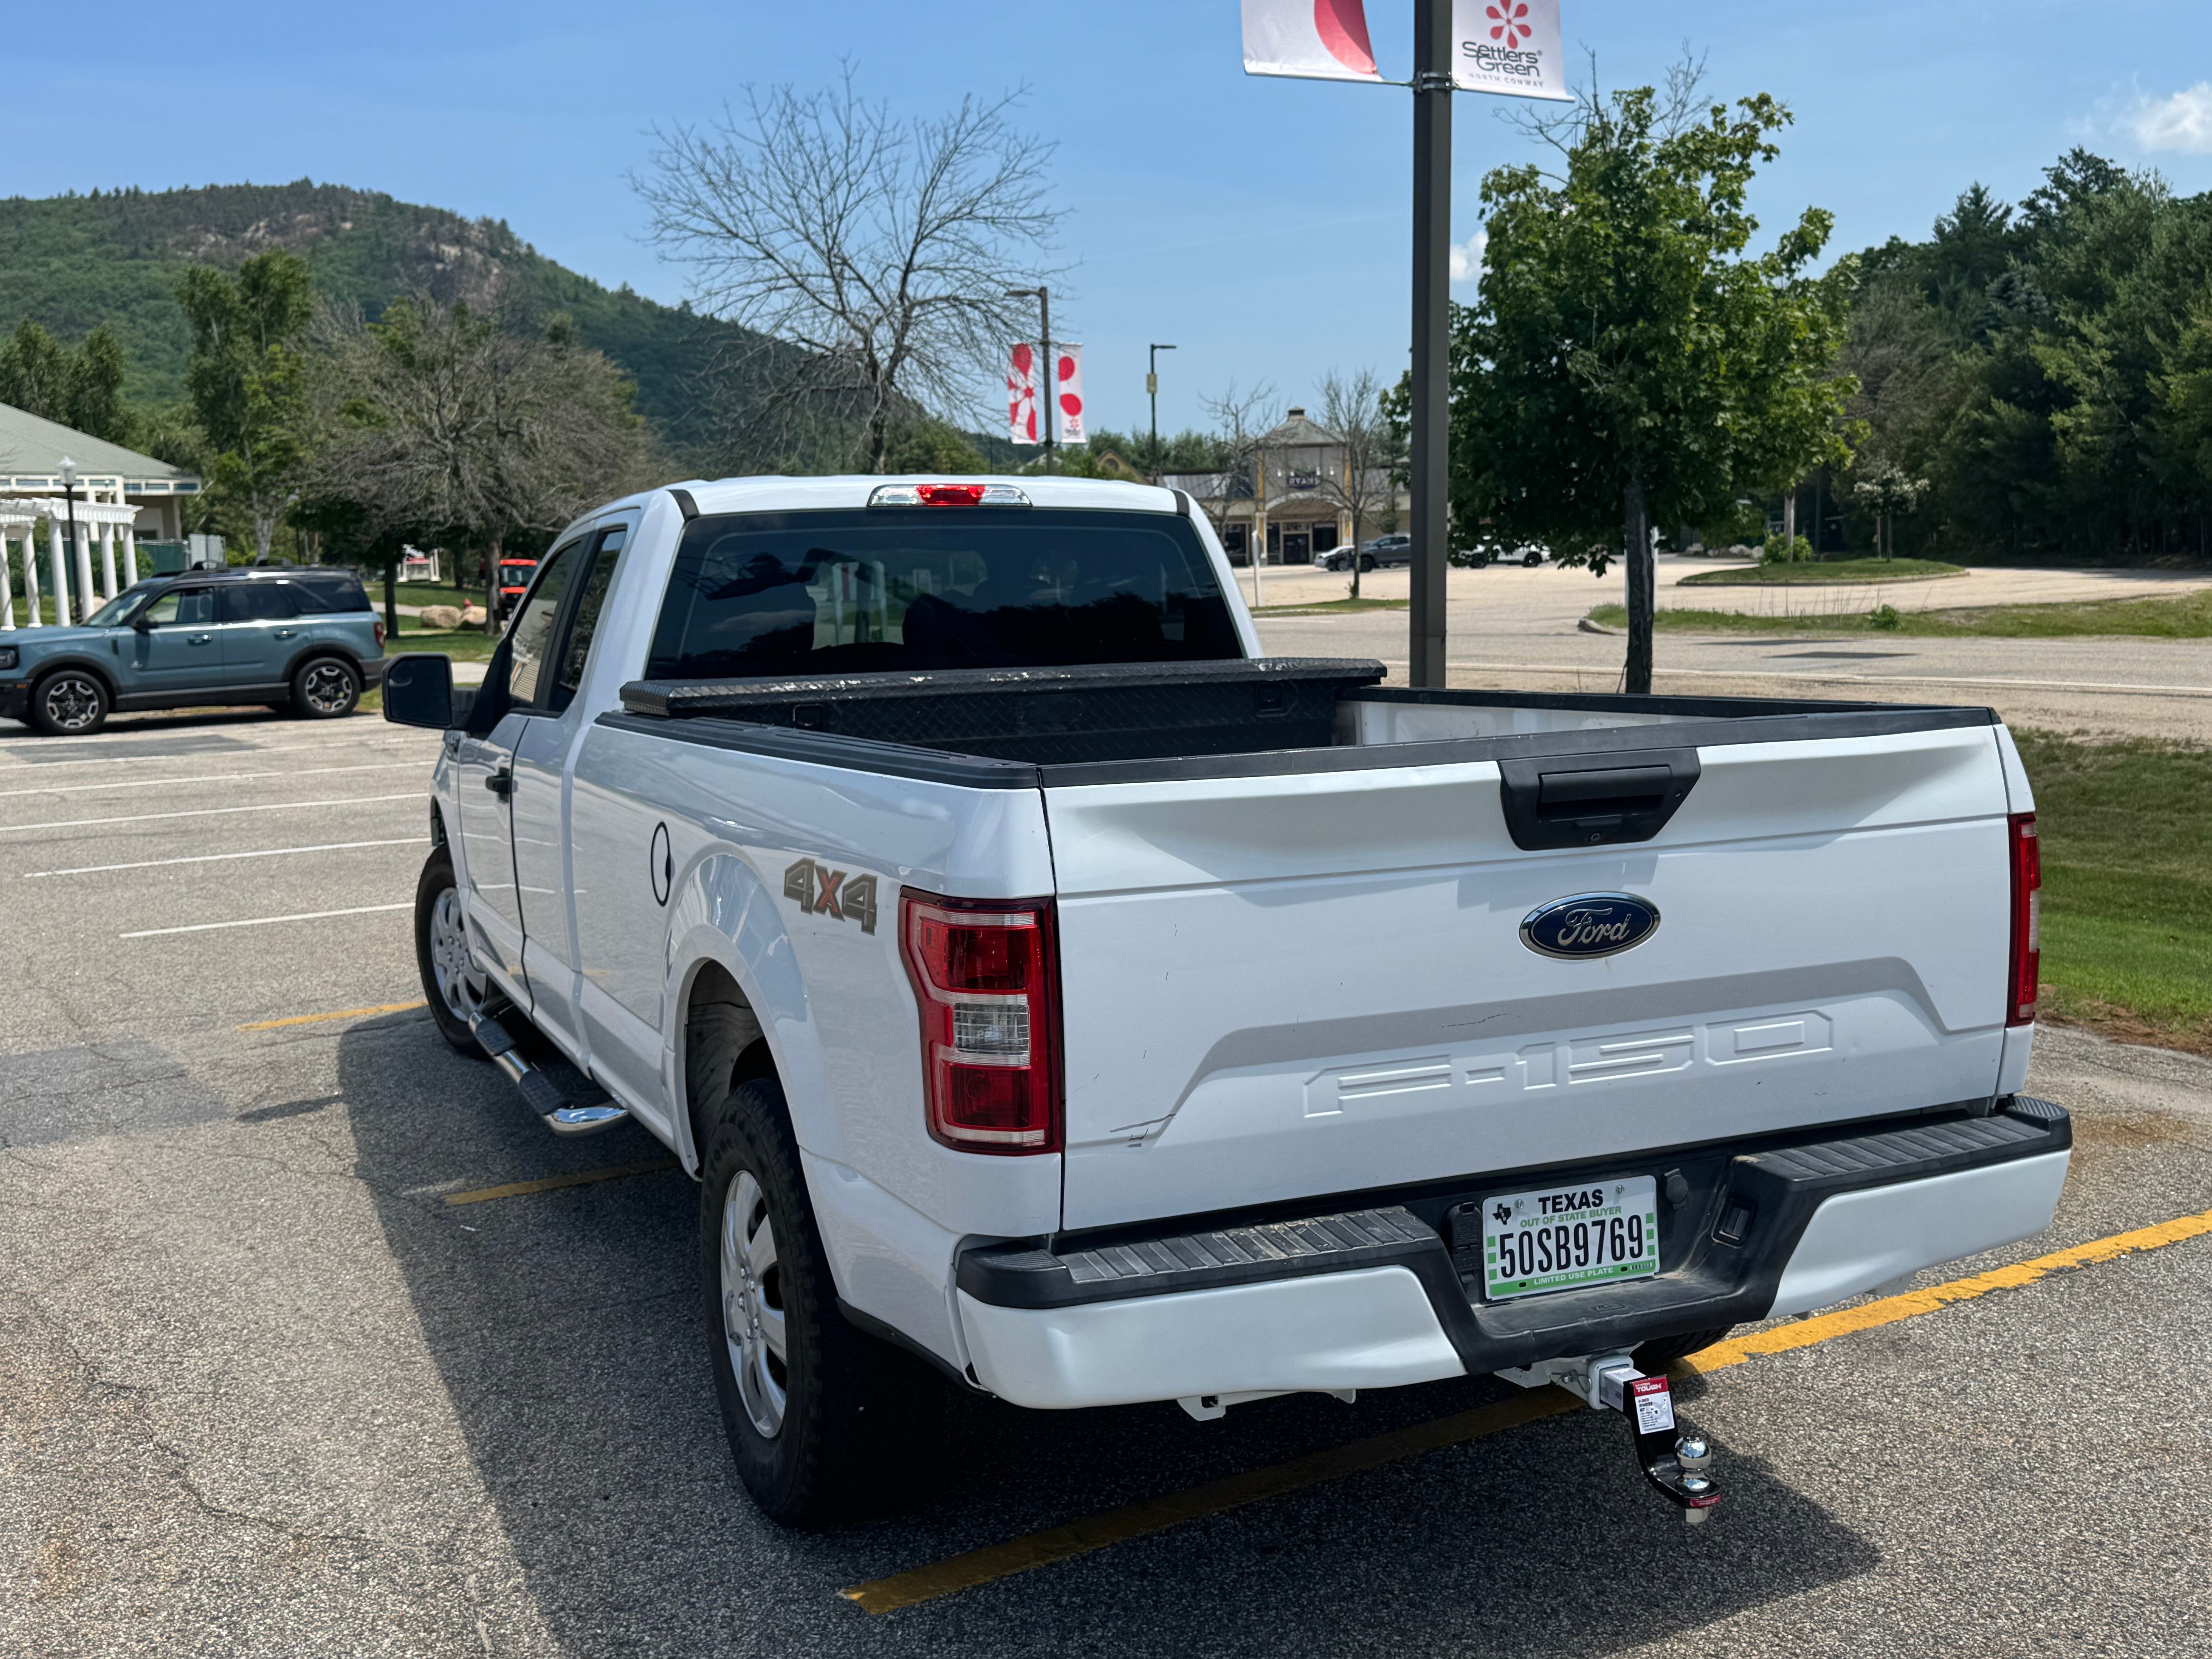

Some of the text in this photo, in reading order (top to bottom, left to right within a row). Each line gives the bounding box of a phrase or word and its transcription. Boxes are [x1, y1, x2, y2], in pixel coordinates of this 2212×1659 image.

[1462, 41, 1538, 64] Settlers
[1477, 57, 1540, 77] Green
[1468, 72, 1543, 88] NORTH CONWAY
[1558, 907, 1632, 946] Ford
[1304, 1009, 1833, 1118] F-150
[1538, 1189, 1603, 1214] TEXAS
[1520, 1206, 1621, 1228] OUT OF STATE BUYER
[1499, 1214, 1643, 1278] 50SB9769
[1534, 1267, 1614, 1285] LIMITED USE PLATE
[1636, 1384, 1662, 1393] TOUGH
